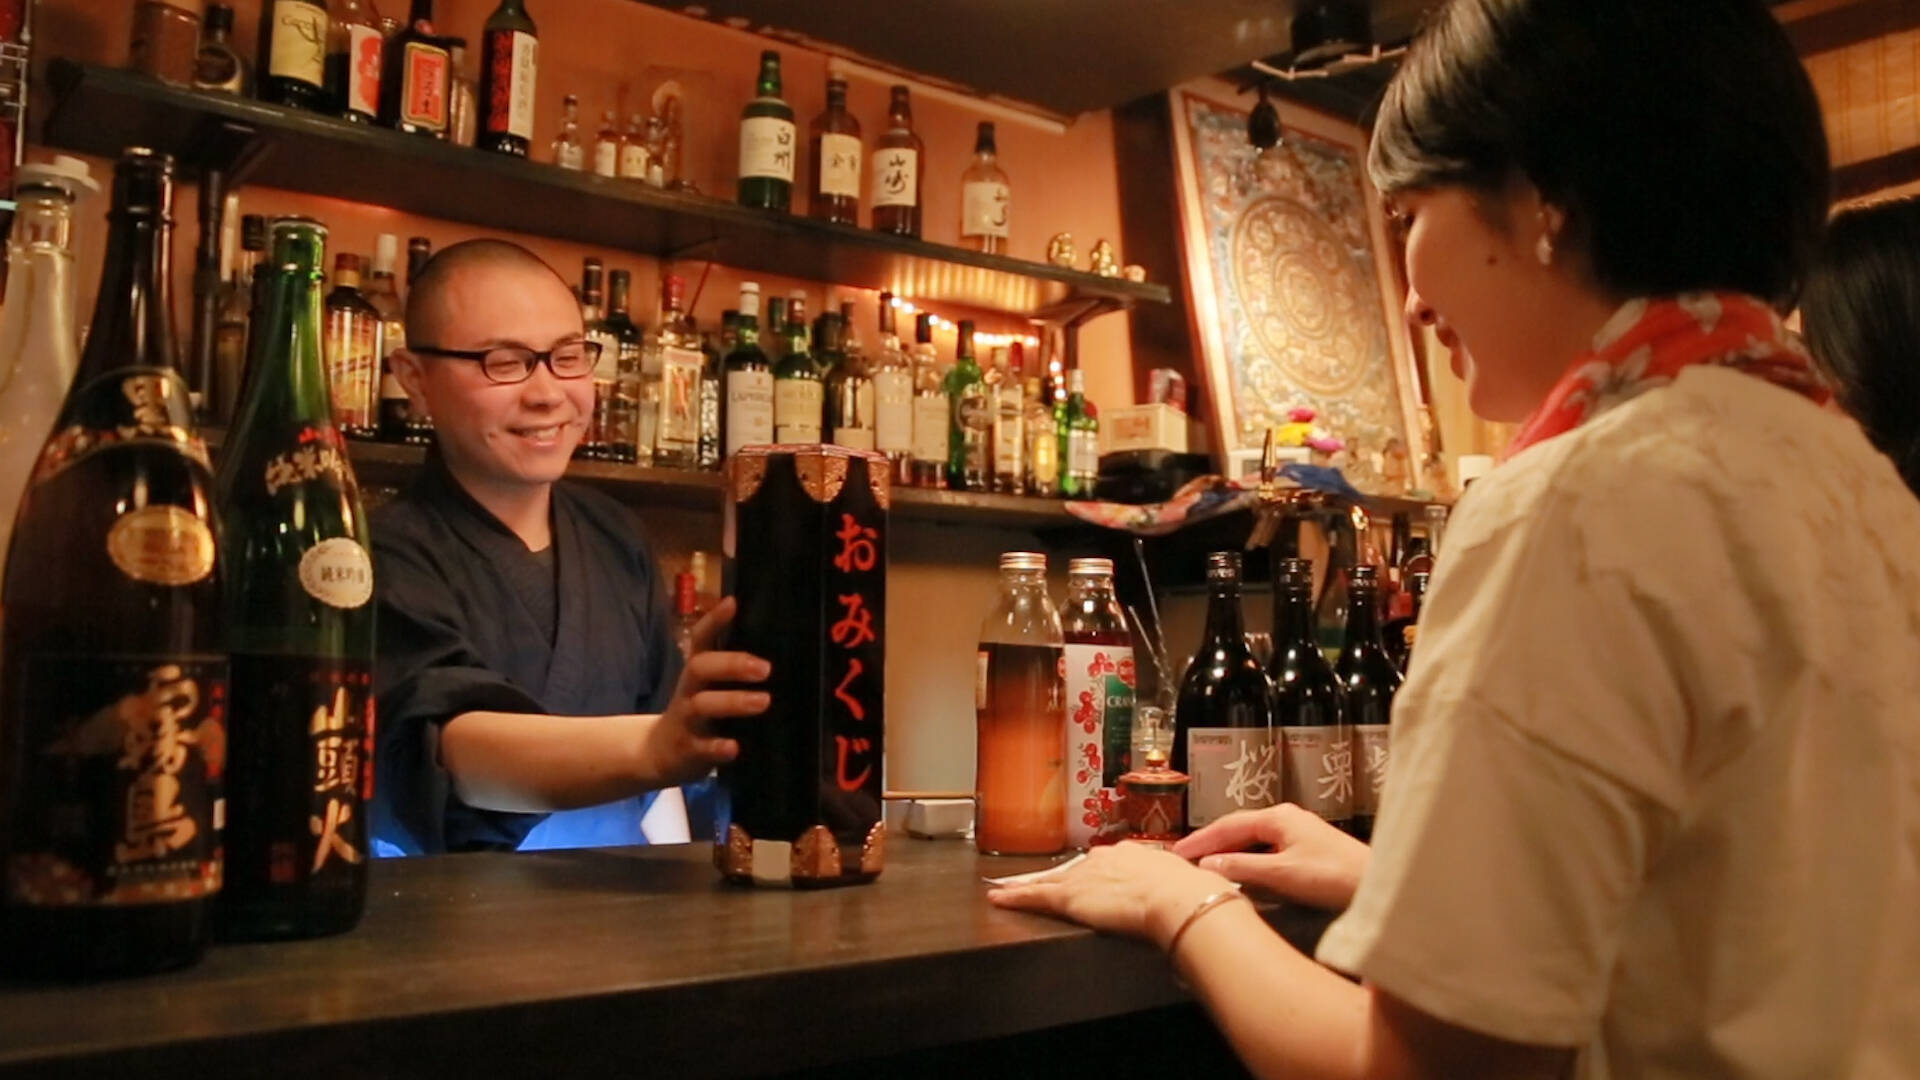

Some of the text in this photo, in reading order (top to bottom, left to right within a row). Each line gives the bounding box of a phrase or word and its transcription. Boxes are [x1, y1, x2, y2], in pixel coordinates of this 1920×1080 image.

[885, 153, 909, 195] 山崎
[830, 513, 878, 791] おみくじ
[308, 685, 362, 874] 山頭火
[1223, 739, 1279, 807] 桜
